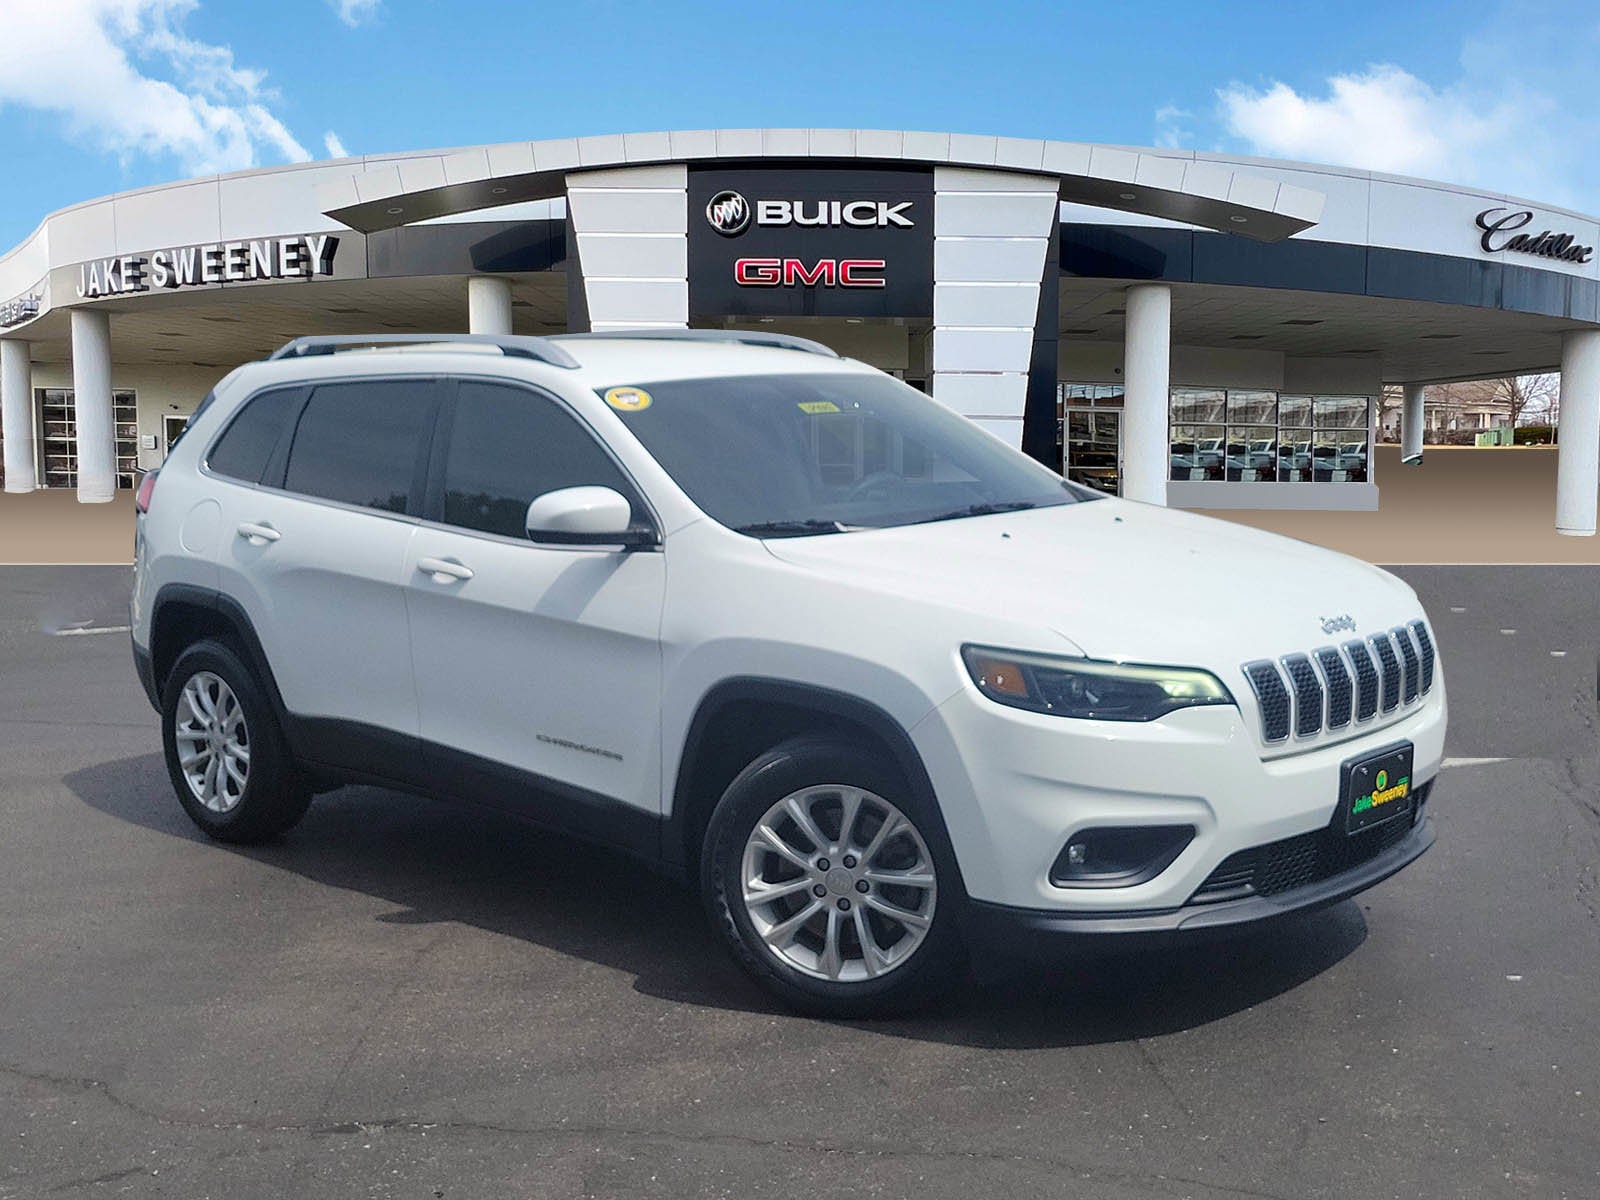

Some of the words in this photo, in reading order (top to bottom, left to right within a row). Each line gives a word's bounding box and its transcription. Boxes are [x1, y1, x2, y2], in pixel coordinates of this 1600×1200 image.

[756, 200, 914, 227] BUICK
[1475, 207, 1593, 263] Cadillac
[76, 256, 147, 298] JAKE
[151, 235, 338, 288] SWEENEY
[734, 258, 886, 287] GMC
